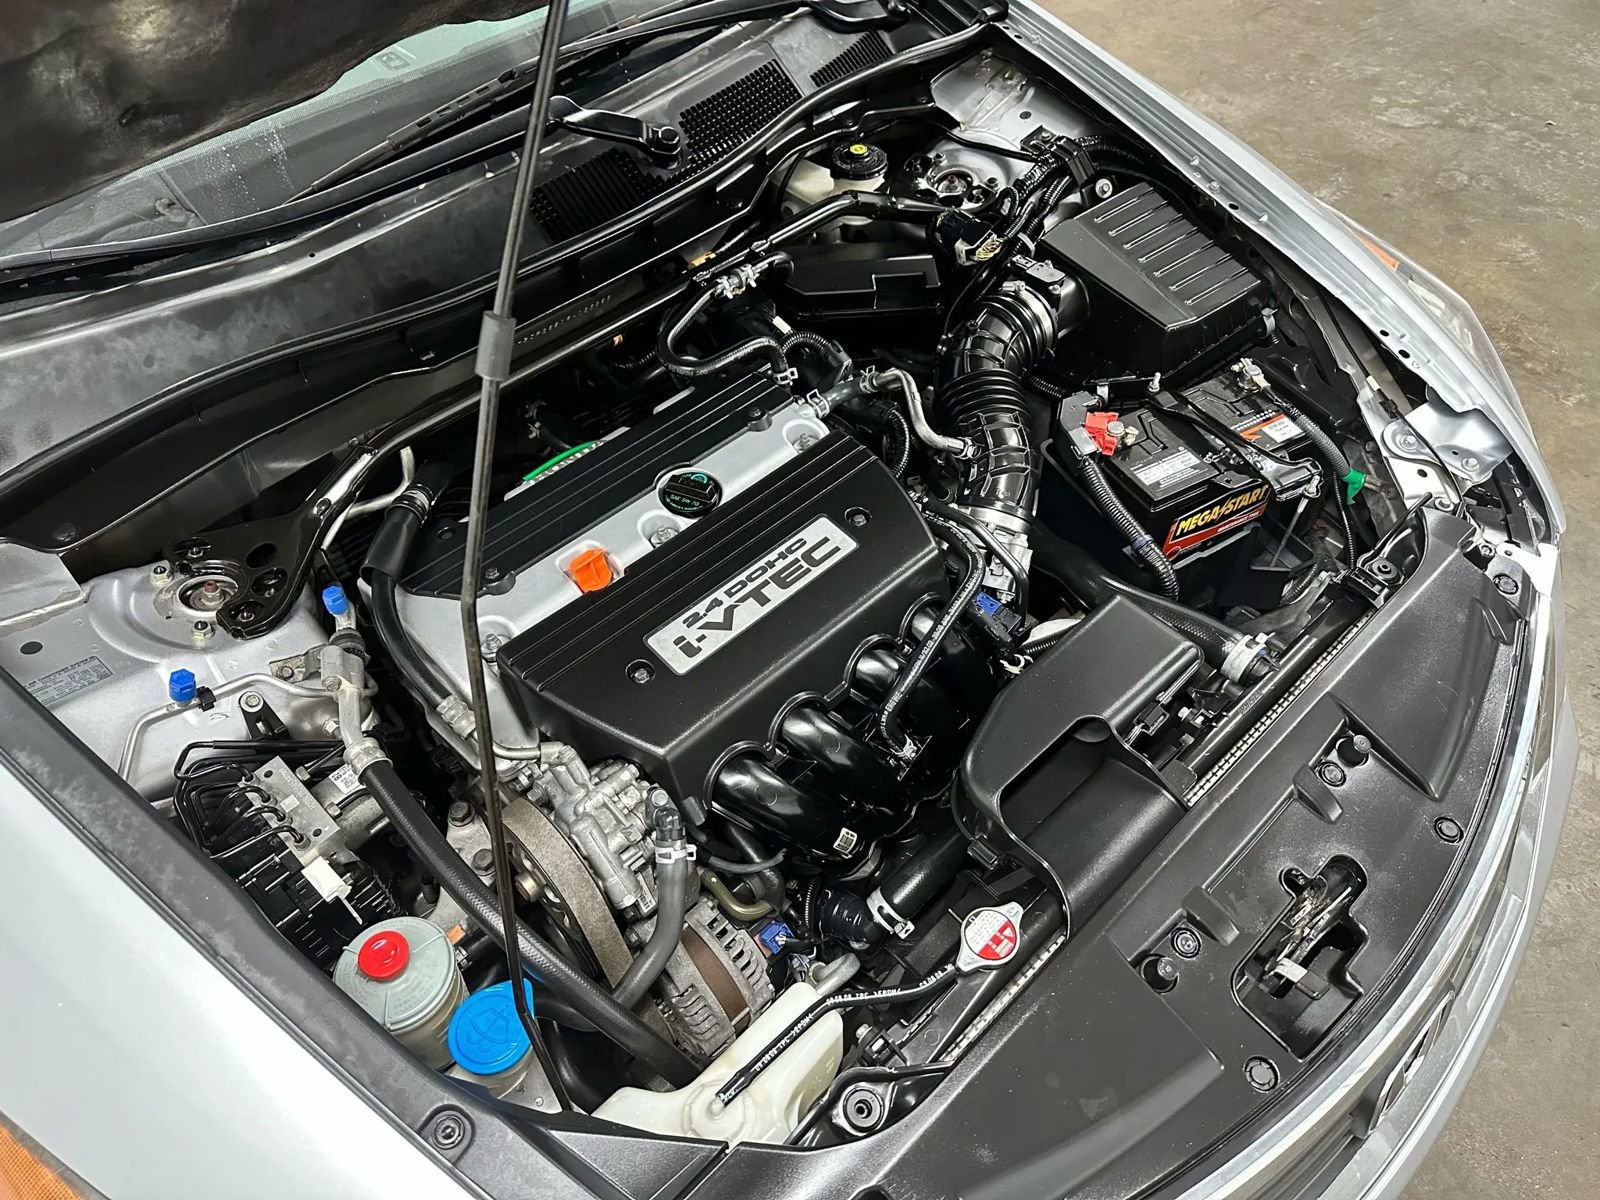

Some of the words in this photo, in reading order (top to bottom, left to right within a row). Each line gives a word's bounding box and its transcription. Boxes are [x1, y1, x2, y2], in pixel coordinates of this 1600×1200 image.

[1175, 506, 1221, 536] MEGA
[1223, 485, 1269, 515] START
[672, 536, 841, 658] i-VTEC
[682, 597, 724, 629] 2.4
[723, 537, 807, 598] DOHC
